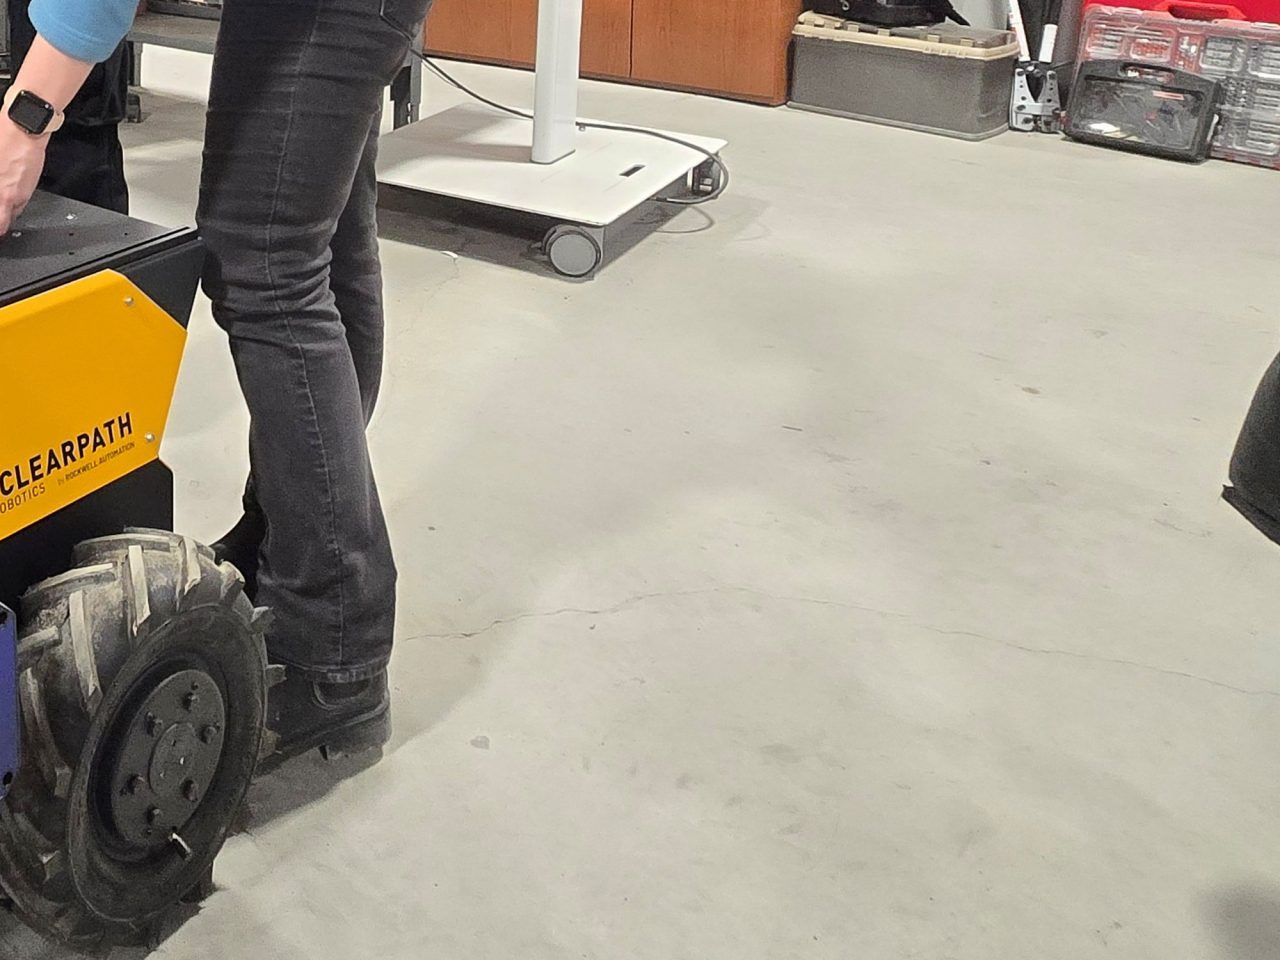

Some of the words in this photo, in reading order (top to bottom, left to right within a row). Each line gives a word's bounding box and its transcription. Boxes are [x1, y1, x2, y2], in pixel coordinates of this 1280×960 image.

[0, 411, 133, 496] CLEARPATH
[65, 461, 98, 481] ROCKWELL
[98, 441, 135, 465] AUTOMATION
